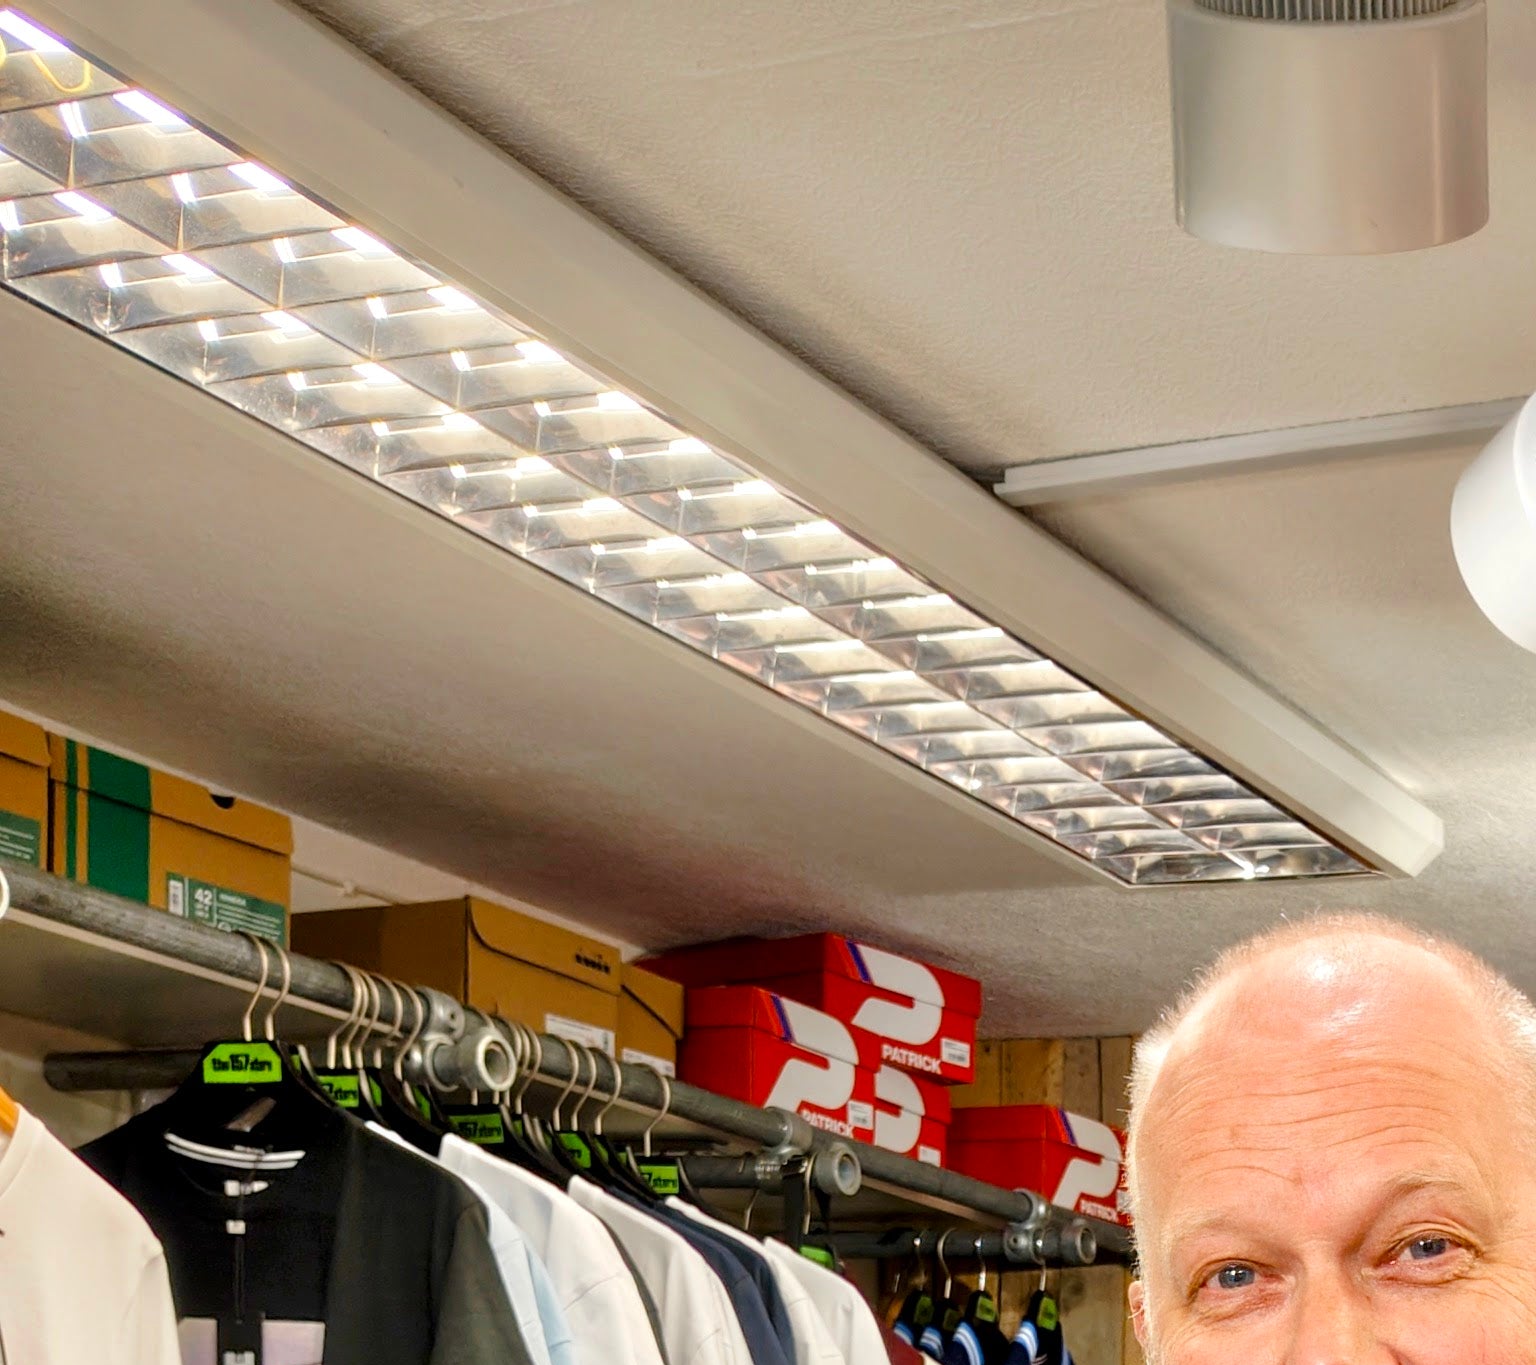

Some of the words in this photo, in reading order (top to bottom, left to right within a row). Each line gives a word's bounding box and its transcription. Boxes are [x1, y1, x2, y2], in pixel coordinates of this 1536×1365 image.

[194, 888, 213, 905] 42
[881, 1043, 942, 1075] PATRICK
[800, 1108, 855, 1139] PATRICK
